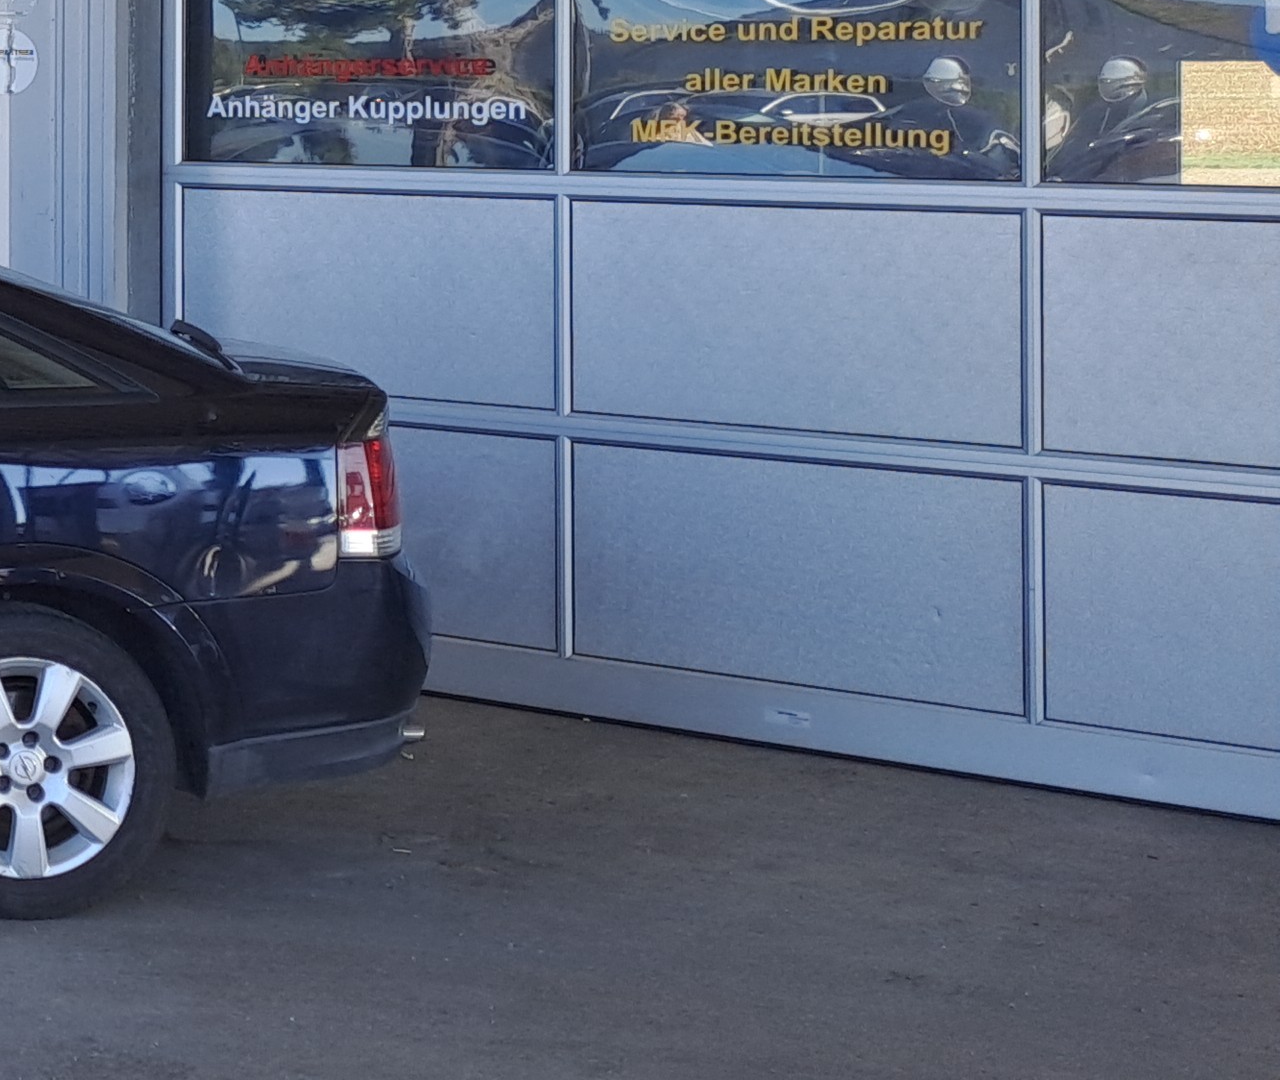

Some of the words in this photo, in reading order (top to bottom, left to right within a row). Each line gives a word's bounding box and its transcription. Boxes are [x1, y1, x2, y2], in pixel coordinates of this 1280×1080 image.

[609, 17, 726, 43] Service
[737, 17, 799, 42] und
[810, 16, 984, 47] Reparatur
[684, 67, 755, 93] aller
[765, 67, 888, 94] Marken
[206, 95, 340, 125] Anhänger
[630, 118, 951, 156] MFK-Bereitstellung
